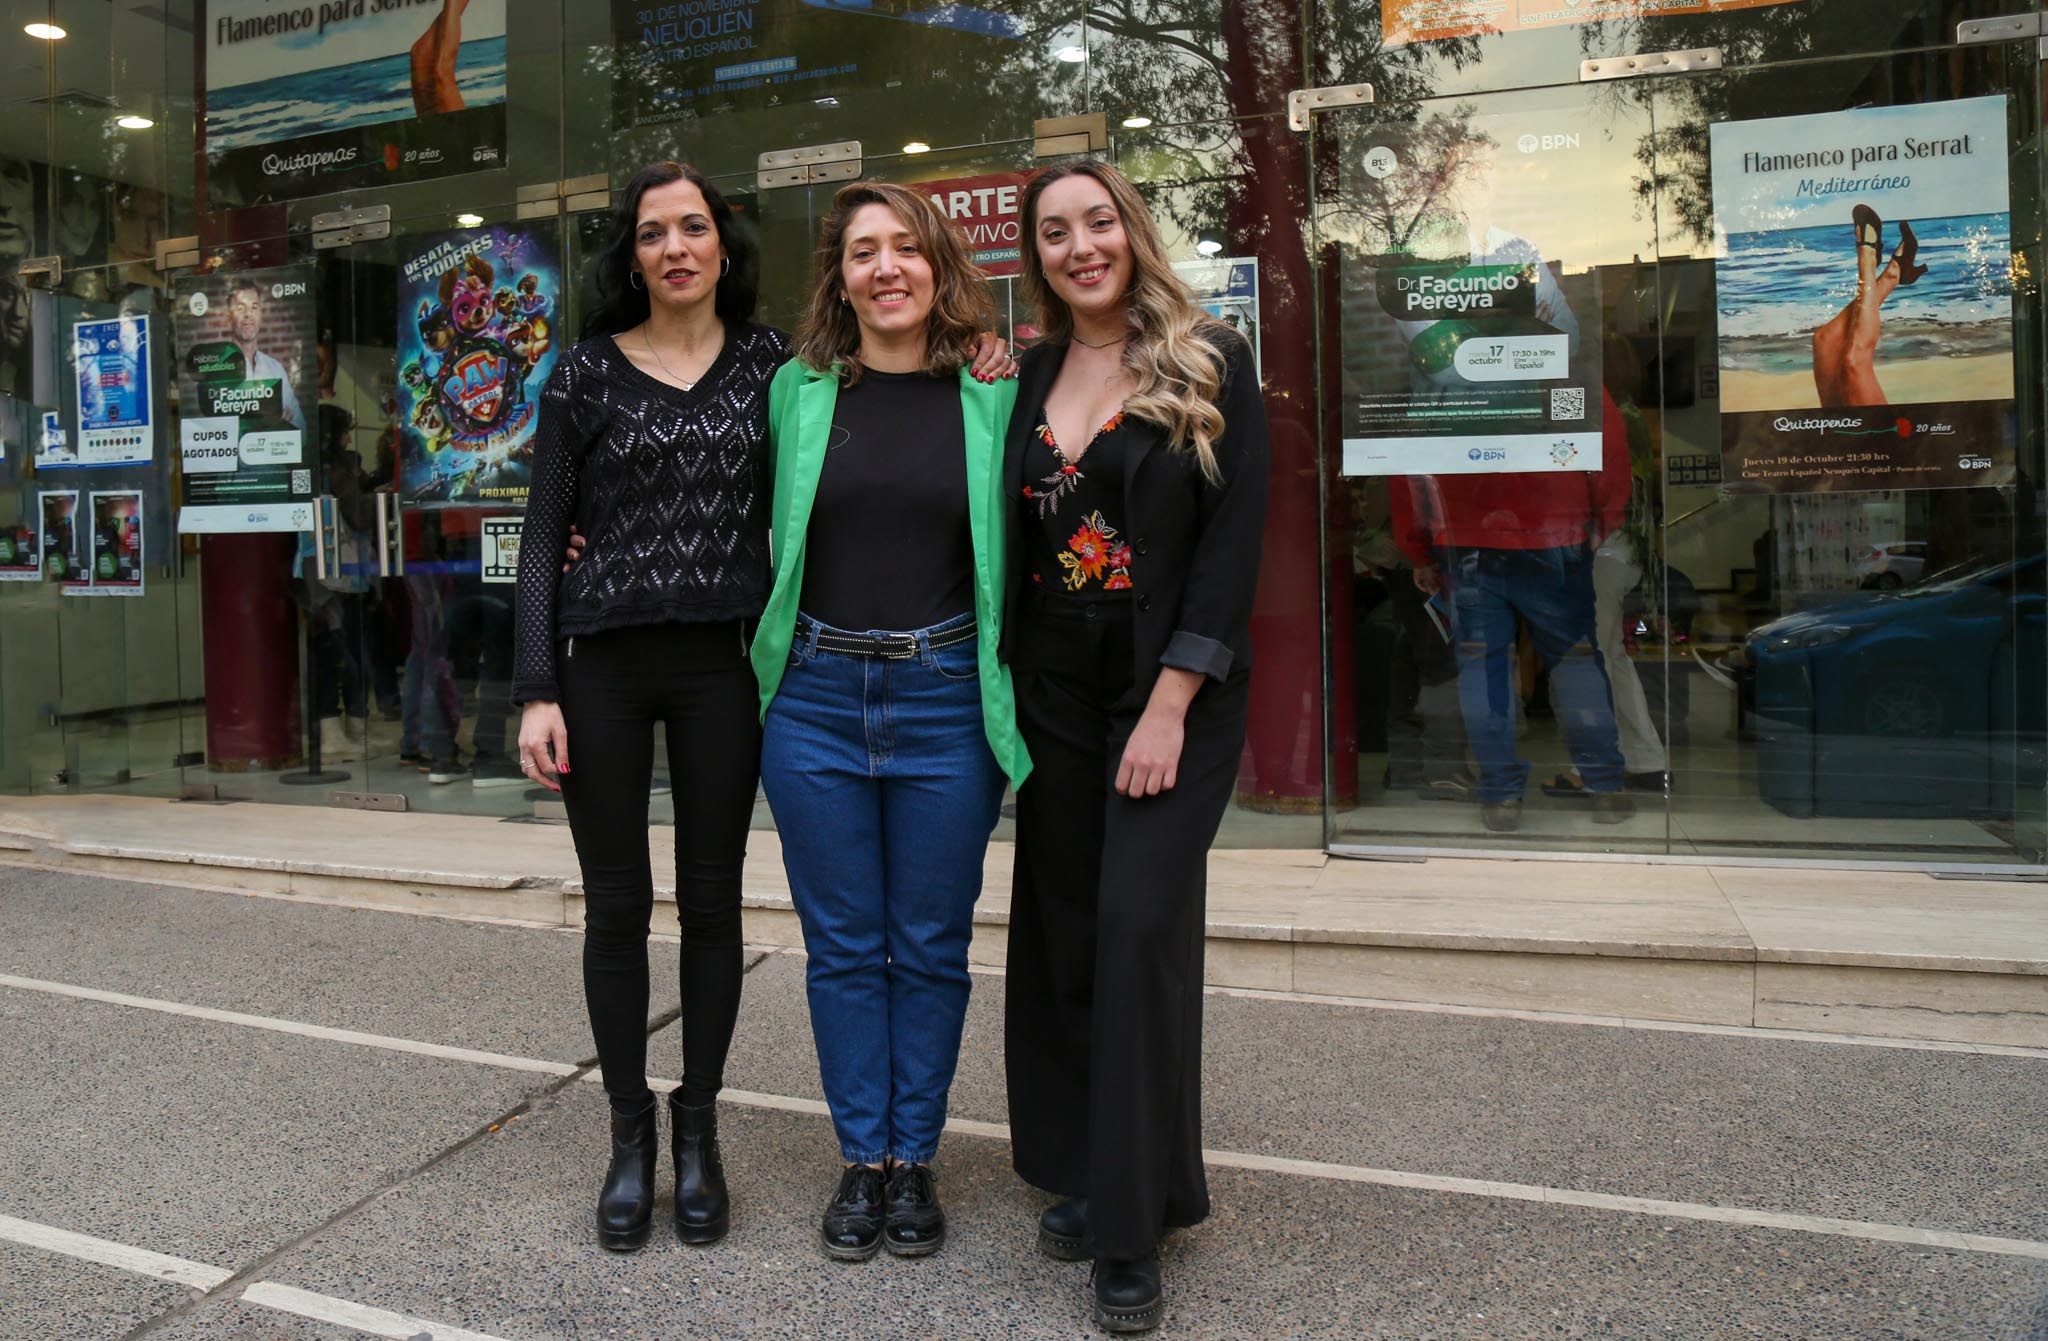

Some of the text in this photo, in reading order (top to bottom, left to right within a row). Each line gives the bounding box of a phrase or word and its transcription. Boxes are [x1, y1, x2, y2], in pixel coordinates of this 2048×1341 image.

[658, 6, 677, 20] DE
[680, 0, 760, 17] NOVIEM
[217, 8, 313, 45] Flamenco
[318, 0, 364, 34] para
[643, 8, 752, 46] NEUQUÉN
[694, 36, 758, 58] ESPAÑOL
[1542, 133, 1580, 150] BPN
[262, 147, 498, 176] Quitapenas 20 años BPN
[1743, 134, 1973, 173] Flamenco para Serrat
[1796, 174, 1911, 197] Mediterráneo
[963, 221, 1019, 244] VIVO
[404, 241, 453, 275] DESATA
[422, 233, 494, 283] PODERES
[976, 250, 1020, 262] TRO ESPAÑO
[284, 282, 306, 296] BPN
[1398, 272, 1519, 293] Dr. Facundo
[1407, 292, 1493, 312] Pereyra
[1490, 345, 1504, 357] 17
[1512, 350, 1532, 358] 17:30
[1469, 357, 1502, 365] octubre
[1514, 361, 1544, 370] Español
[444, 356, 508, 406] PAW
[220, 385, 274, 400] Facundo
[213, 399, 260, 414] Pereyra
[1773, 416, 1952, 435] Quitapenas 20 años
[193, 431, 228, 441] CUPOS
[183, 447, 239, 459] AGOTADOS
[1484, 450, 1505, 461] BPN
[1742, 457, 1775, 468] Jueves
[1777, 456, 1787, 464] 19
[1790, 455, 1802, 464] de
[1804, 454, 1844, 463] Octubre
[1873, 452, 1890, 460] hrs
[1742, 470, 1760, 478] Cine
[1763, 469, 1789, 477] Teatro
[1790, 468, 1821, 478] Español
[1861, 465, 1891, 475] Capital
[1972, 460, 1992, 469] BPN
